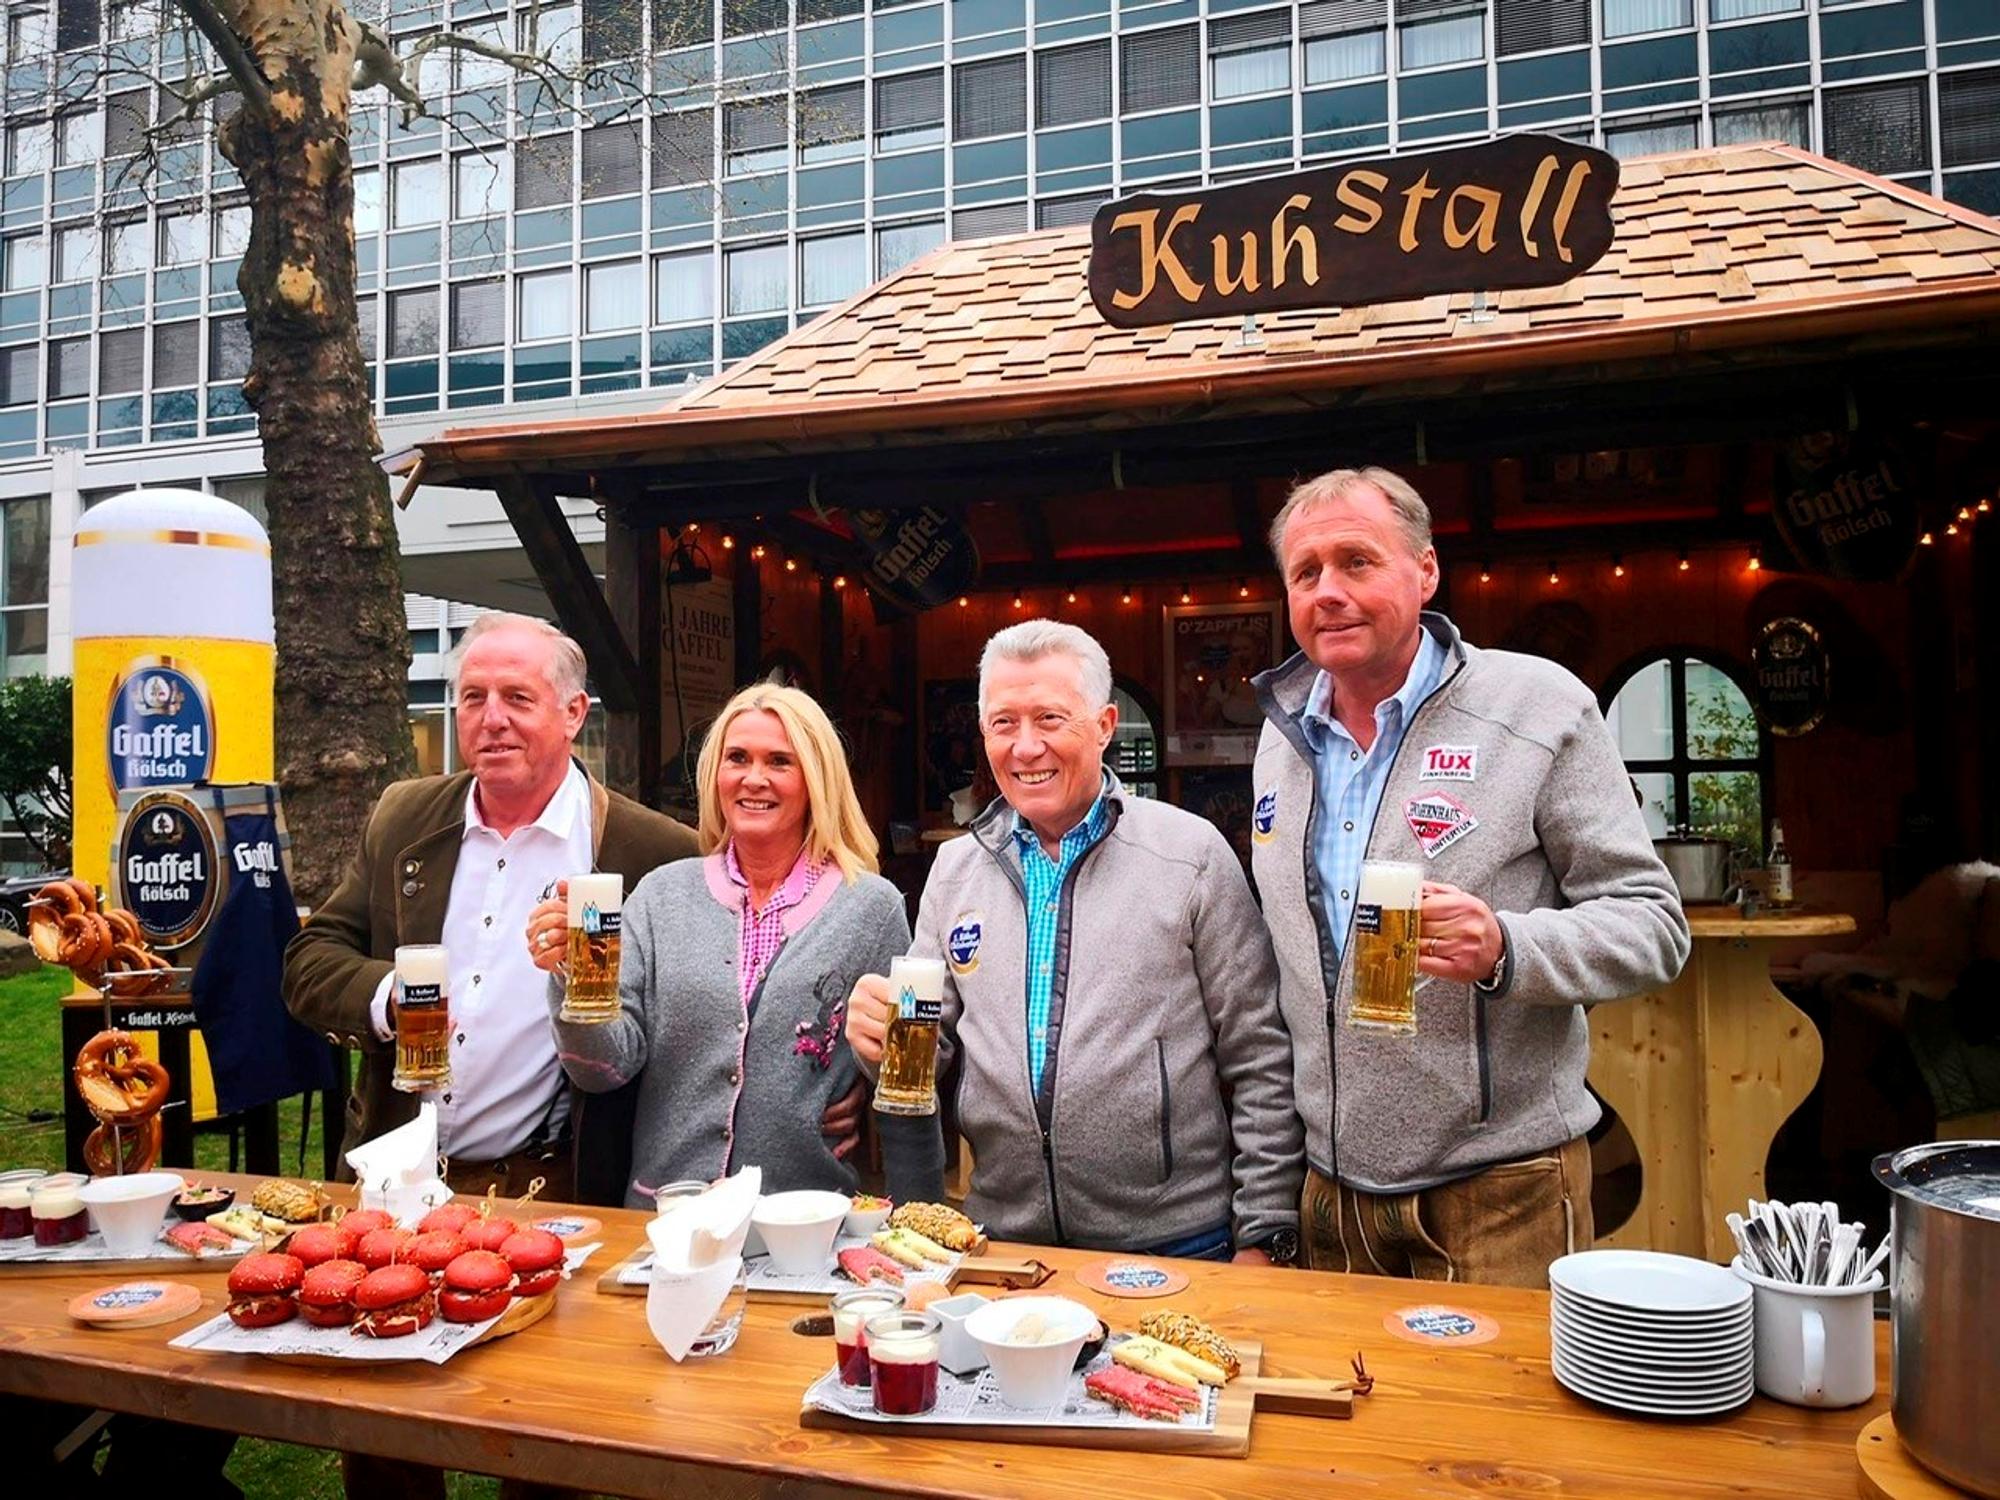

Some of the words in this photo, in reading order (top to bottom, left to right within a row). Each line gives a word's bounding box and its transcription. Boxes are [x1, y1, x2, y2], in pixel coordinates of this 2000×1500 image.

[1785, 460, 1903, 527] Gaffel
[873, 506, 948, 584] Gaffel
[679, 606, 731, 639] JAHRE
[1758, 665, 1822, 689] Gaffel
[112, 724, 205, 759] Gaffel
[127, 758, 188, 778] Kölsch
[1428, 820, 1474, 854] HINTERTUX
[127, 852, 205, 884] Gaffel
[140, 885, 190, 902] Kölsch
[128, 1012, 162, 1026] Gaffel
